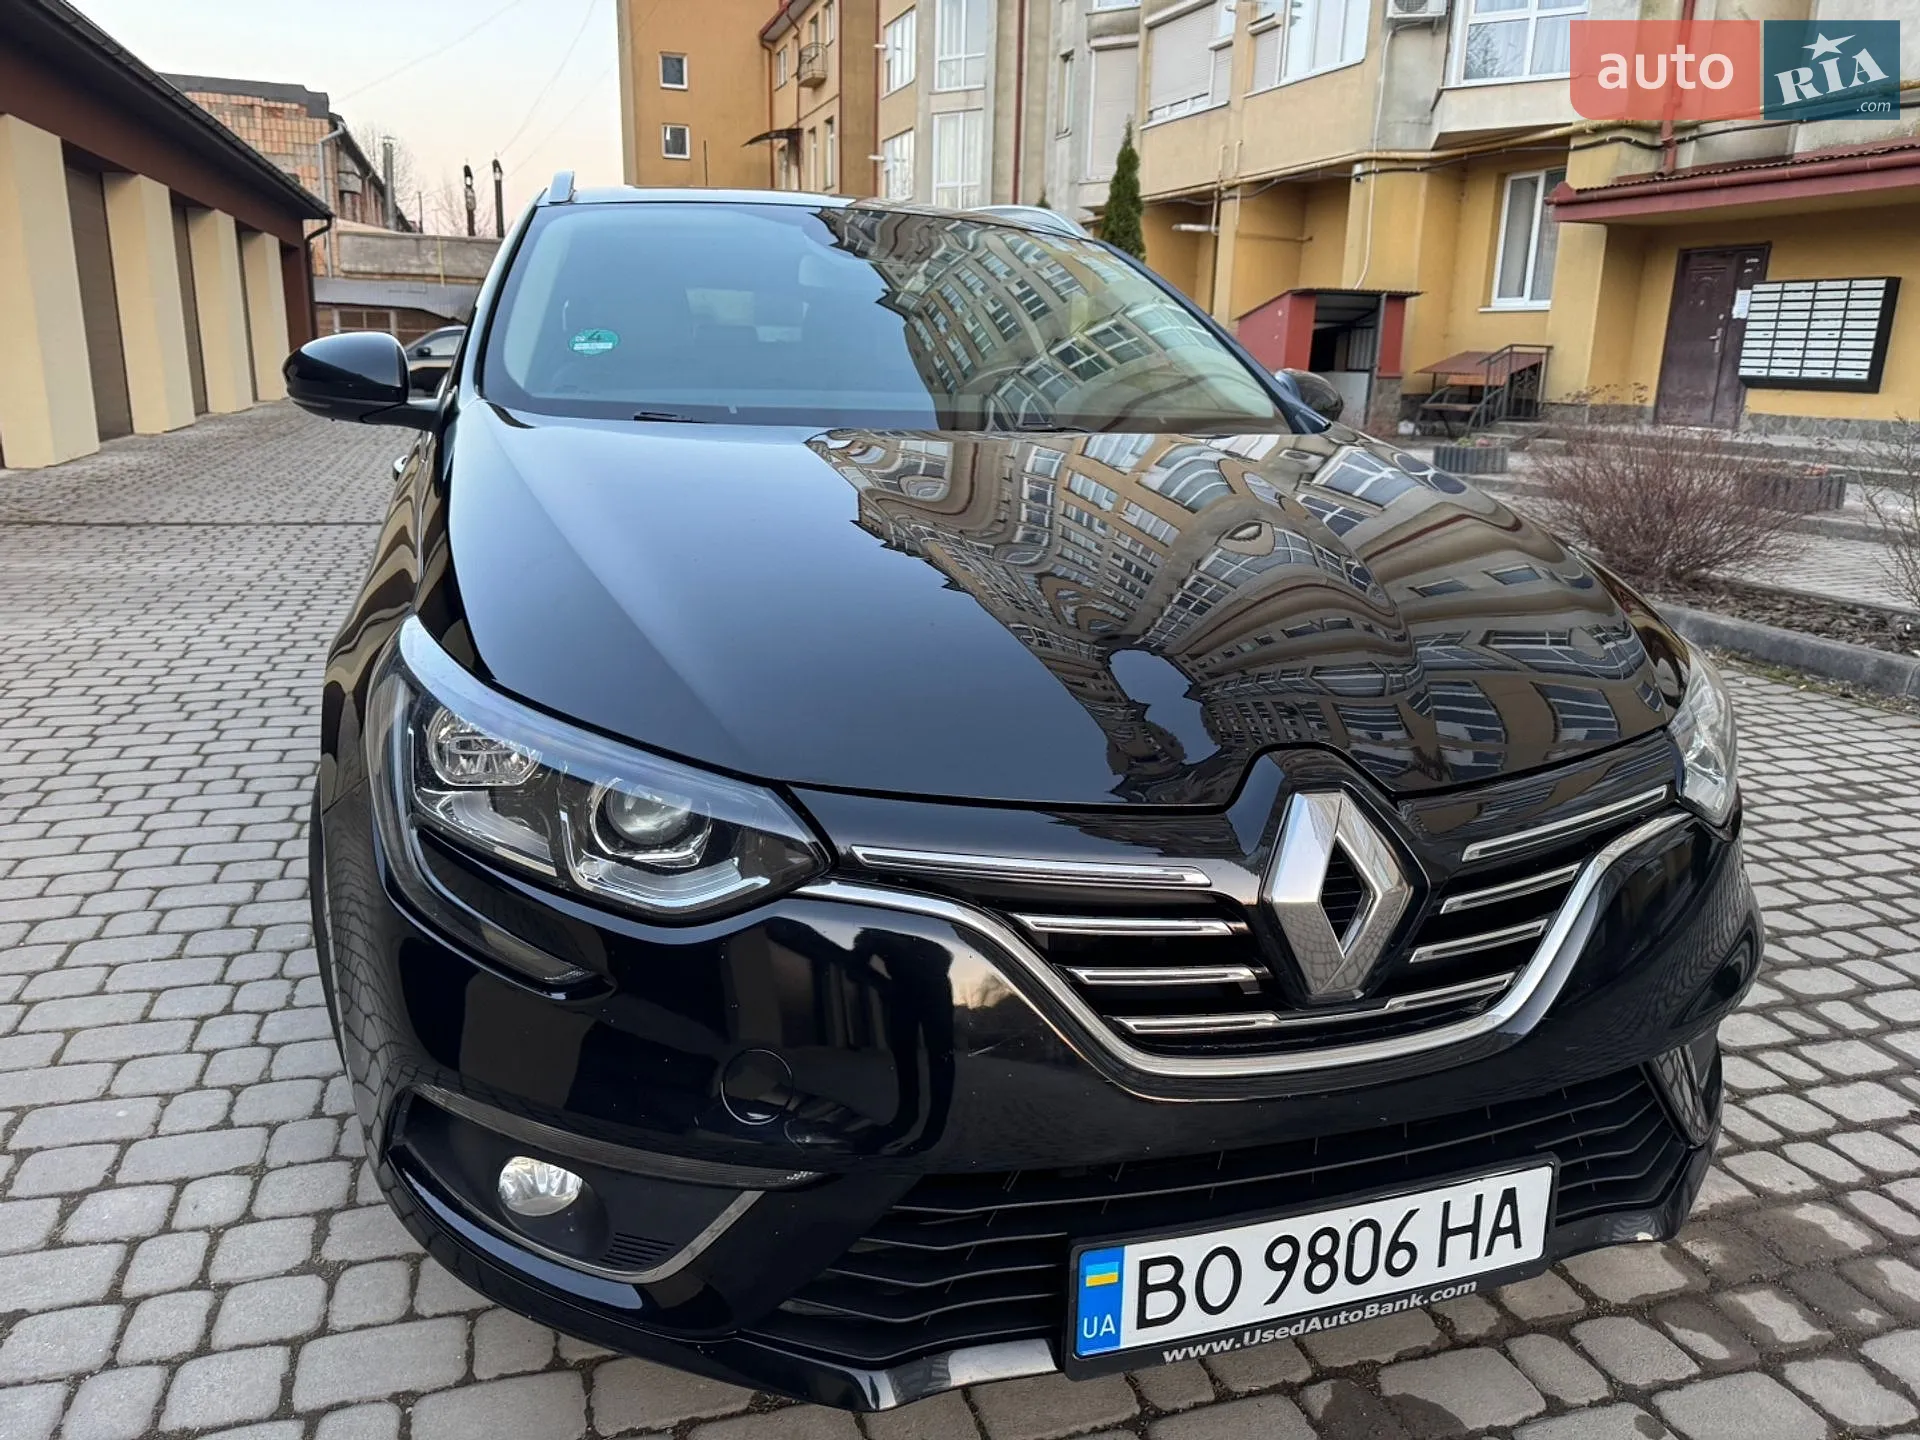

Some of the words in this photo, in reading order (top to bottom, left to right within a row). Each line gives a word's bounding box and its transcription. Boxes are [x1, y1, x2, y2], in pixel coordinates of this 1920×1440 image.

[1136, 1246, 1242, 1330] BO
[1263, 1208, 1419, 1305] 9806
[1437, 1186, 1523, 1268] HA
[1083, 1315, 1116, 1339] UA
[1162, 1279, 1478, 1364] www.UsedAutoBank.com
